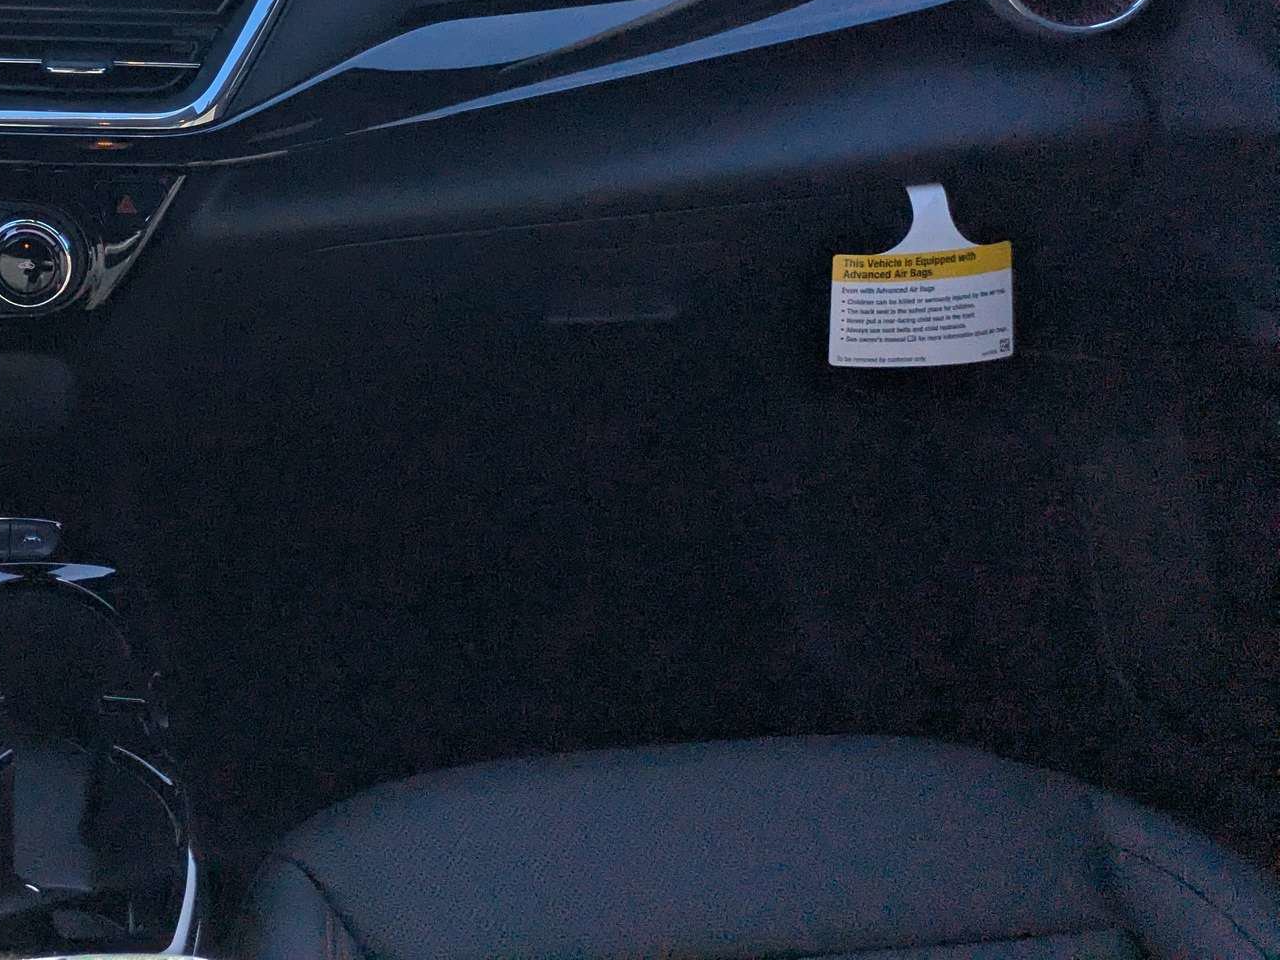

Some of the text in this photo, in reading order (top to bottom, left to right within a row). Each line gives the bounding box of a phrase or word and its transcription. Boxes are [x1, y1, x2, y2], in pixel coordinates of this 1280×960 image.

[844, 258, 865, 268] This
[867, 258, 902, 268] Vehicle
[916, 254, 956, 267] Equipped
[958, 252, 976, 262] with
[844, 268, 933, 279] Advanced Air Bags
